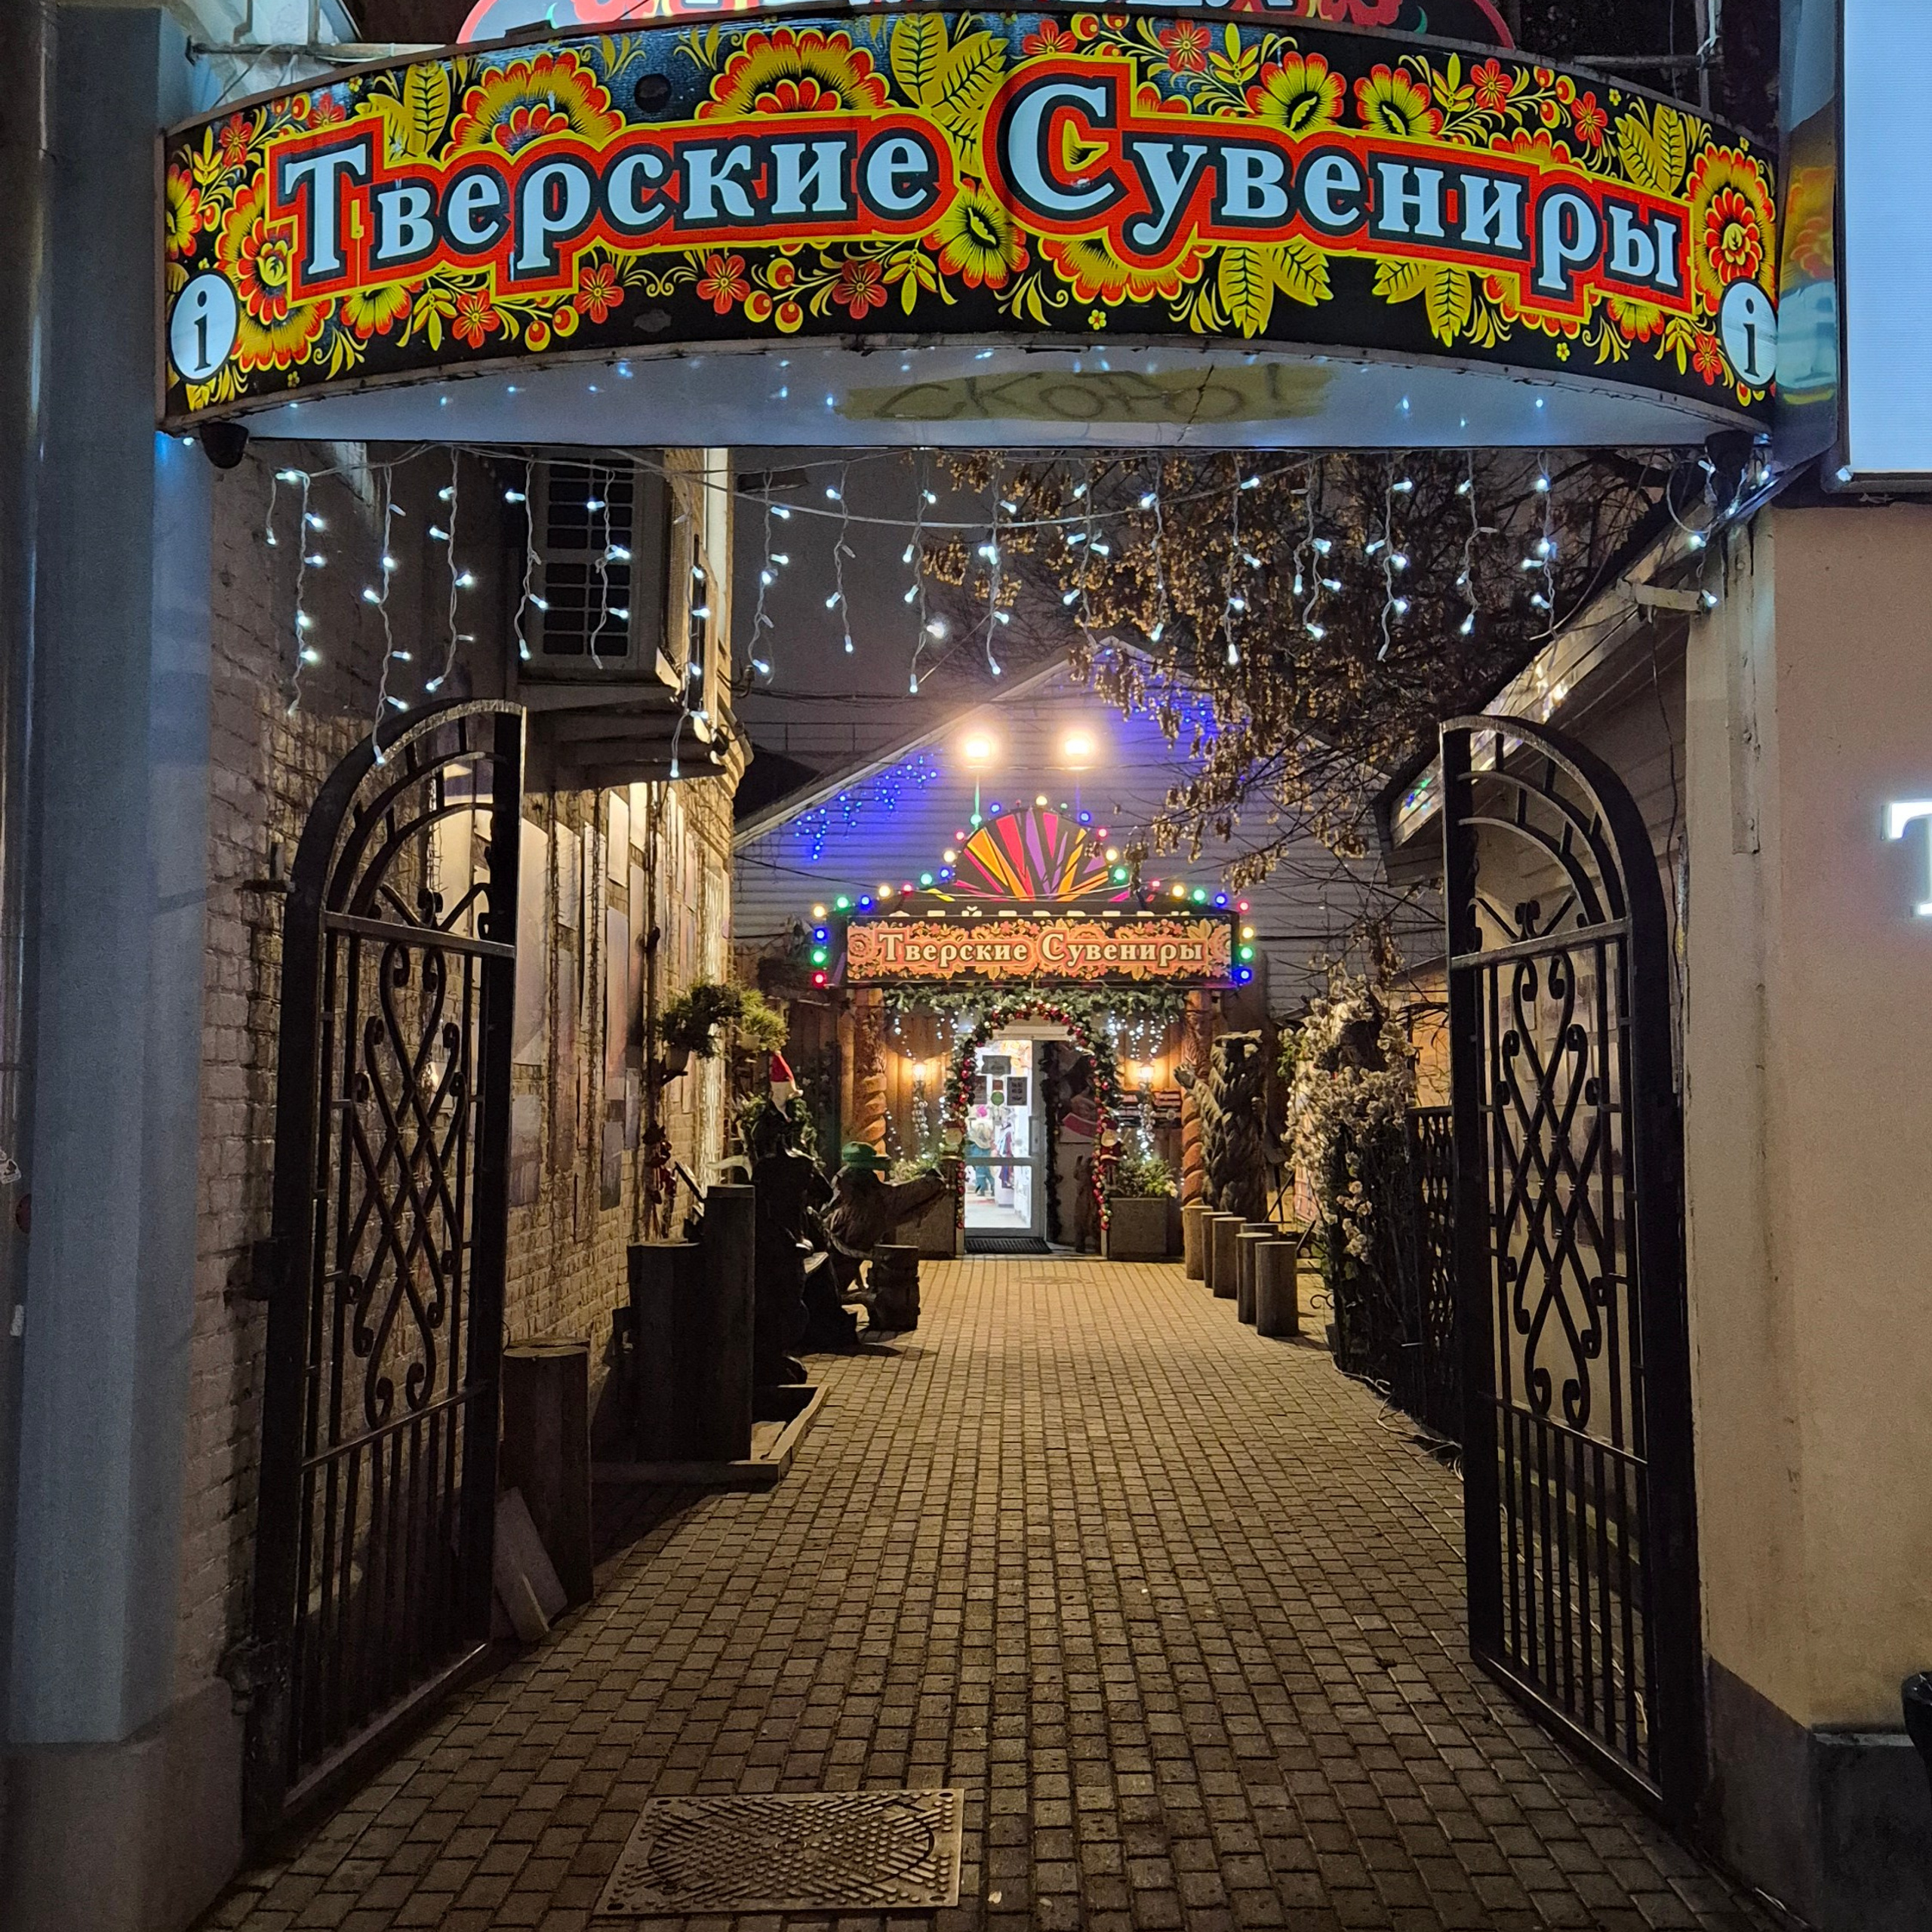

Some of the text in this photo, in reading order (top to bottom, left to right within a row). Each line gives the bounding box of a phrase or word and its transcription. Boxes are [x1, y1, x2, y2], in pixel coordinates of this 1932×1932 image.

[284, 82, 1678, 291] Тверские Сувениры
[879, 934, 1202, 968] Тверские Сувениры
